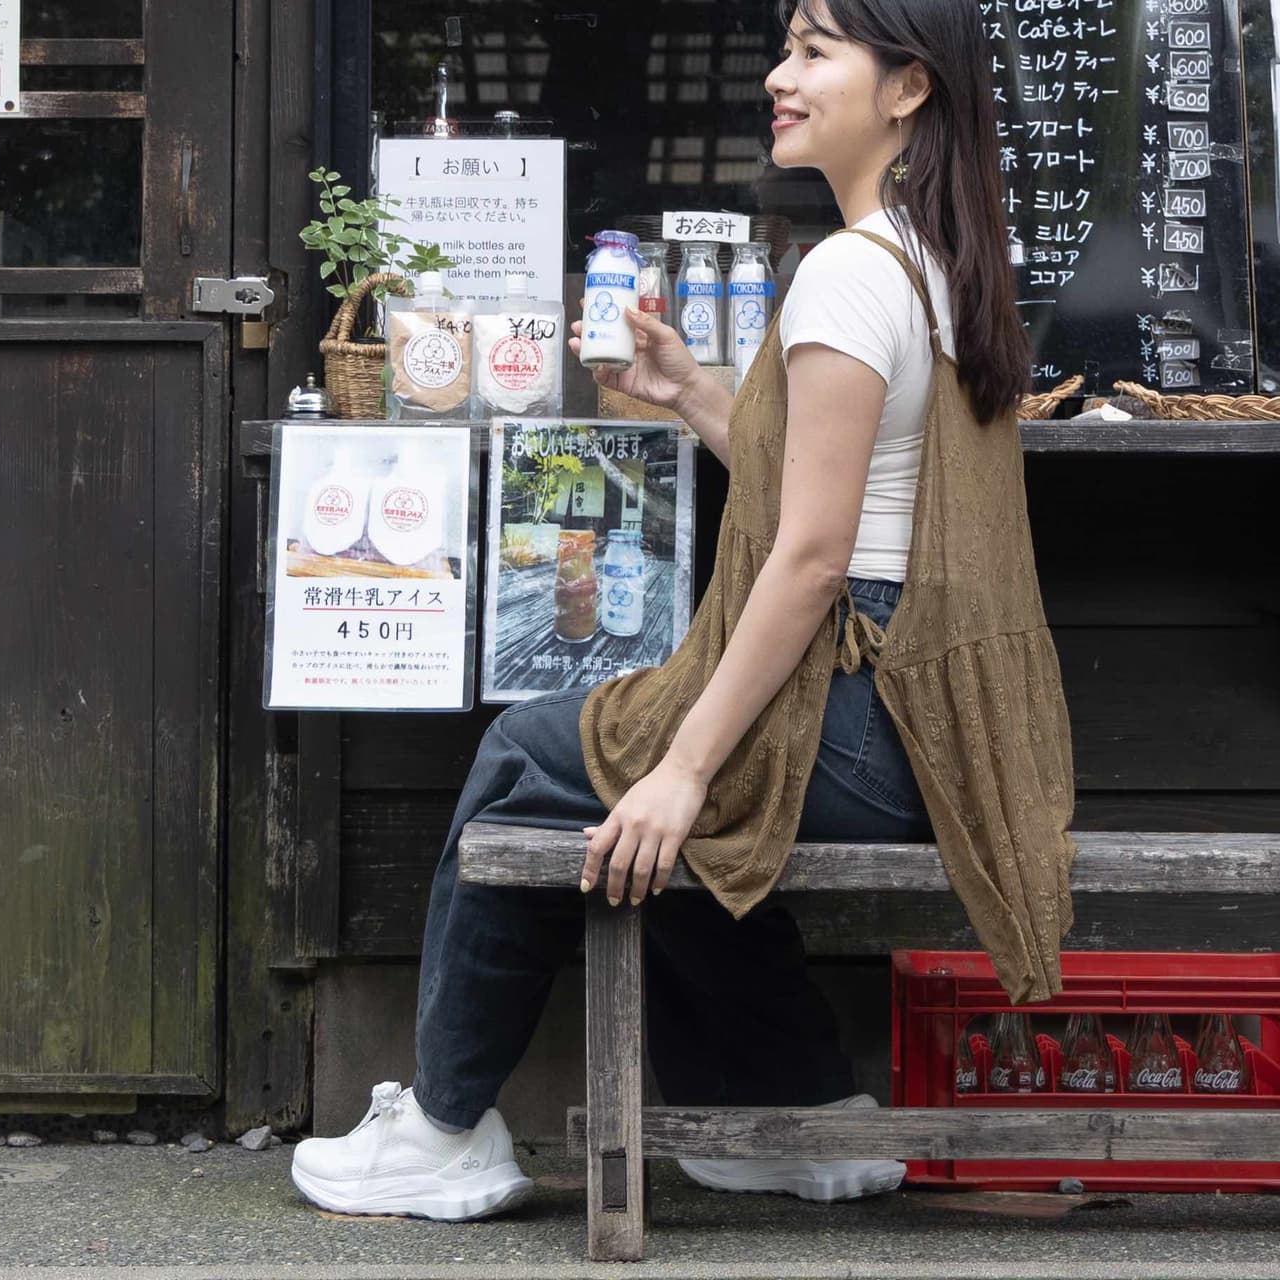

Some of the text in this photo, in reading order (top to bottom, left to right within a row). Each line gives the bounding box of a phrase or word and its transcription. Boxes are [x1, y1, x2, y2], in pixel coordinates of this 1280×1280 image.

[1173, 27, 1206, 45] 600
[1175, 58, 1208, 76] 600
[1172, 90, 1208, 108] 600
[1173, 128, 1205, 147] 700
[1178, 159, 1208, 177] 700
[1034, 188, 1091, 212] ミルク
[1170, 194, 1202, 210] 450
[675, 216, 737, 238] お会計
[443, 239, 465, 251] milk
[468, 239, 505, 251] bottles
[507, 241, 526, 251] are
[1168, 235, 1200, 251] 450
[492, 254, 506, 265] do
[509, 255, 526, 265] not
[447, 268, 468, 279] take
[474, 268, 501, 279] them
[303, 586, 444, 608] 常滑牛乳アイス
